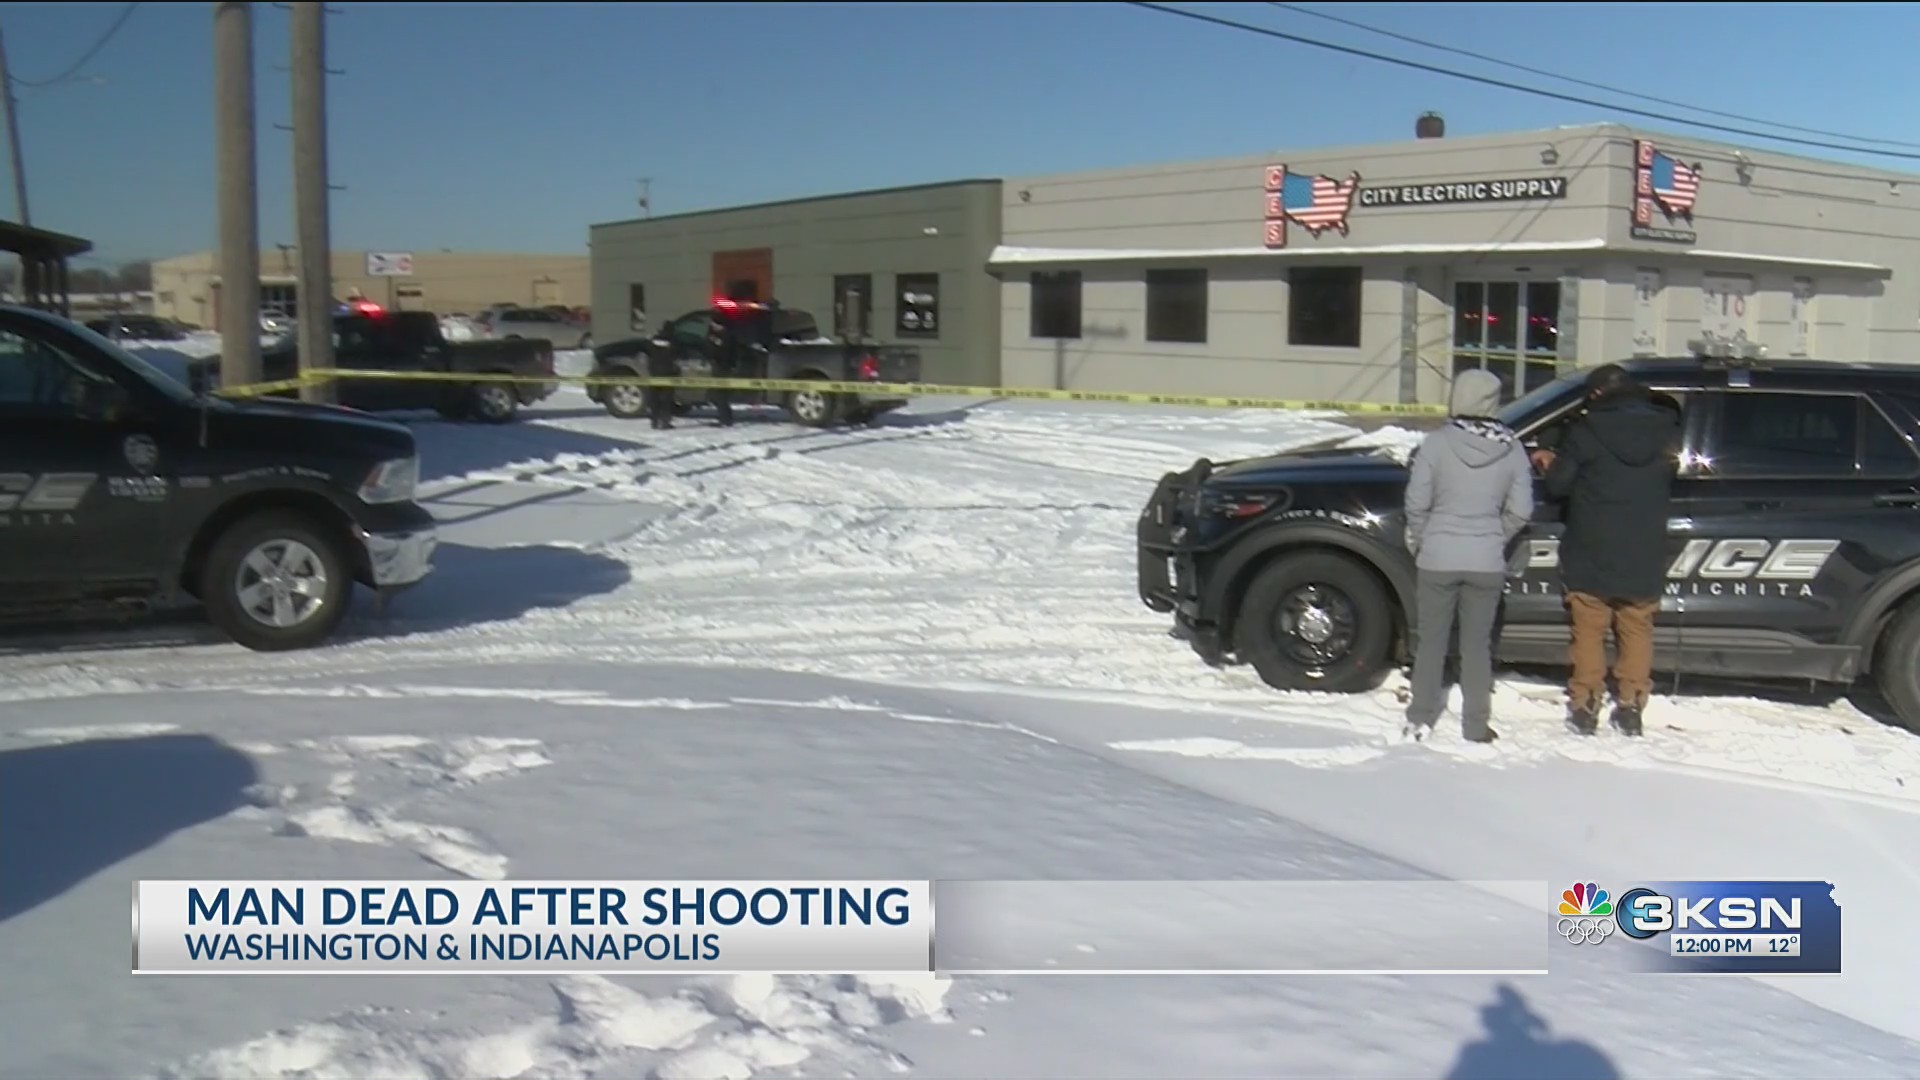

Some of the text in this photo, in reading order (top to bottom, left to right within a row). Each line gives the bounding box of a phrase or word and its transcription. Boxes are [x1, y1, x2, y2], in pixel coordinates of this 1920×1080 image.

[1362, 179, 1562, 204] CITY ELECTRIC SUPPLY
[1267, 167, 1283, 243] CES
[1503, 581, 1813, 596] CIT WICHITA
